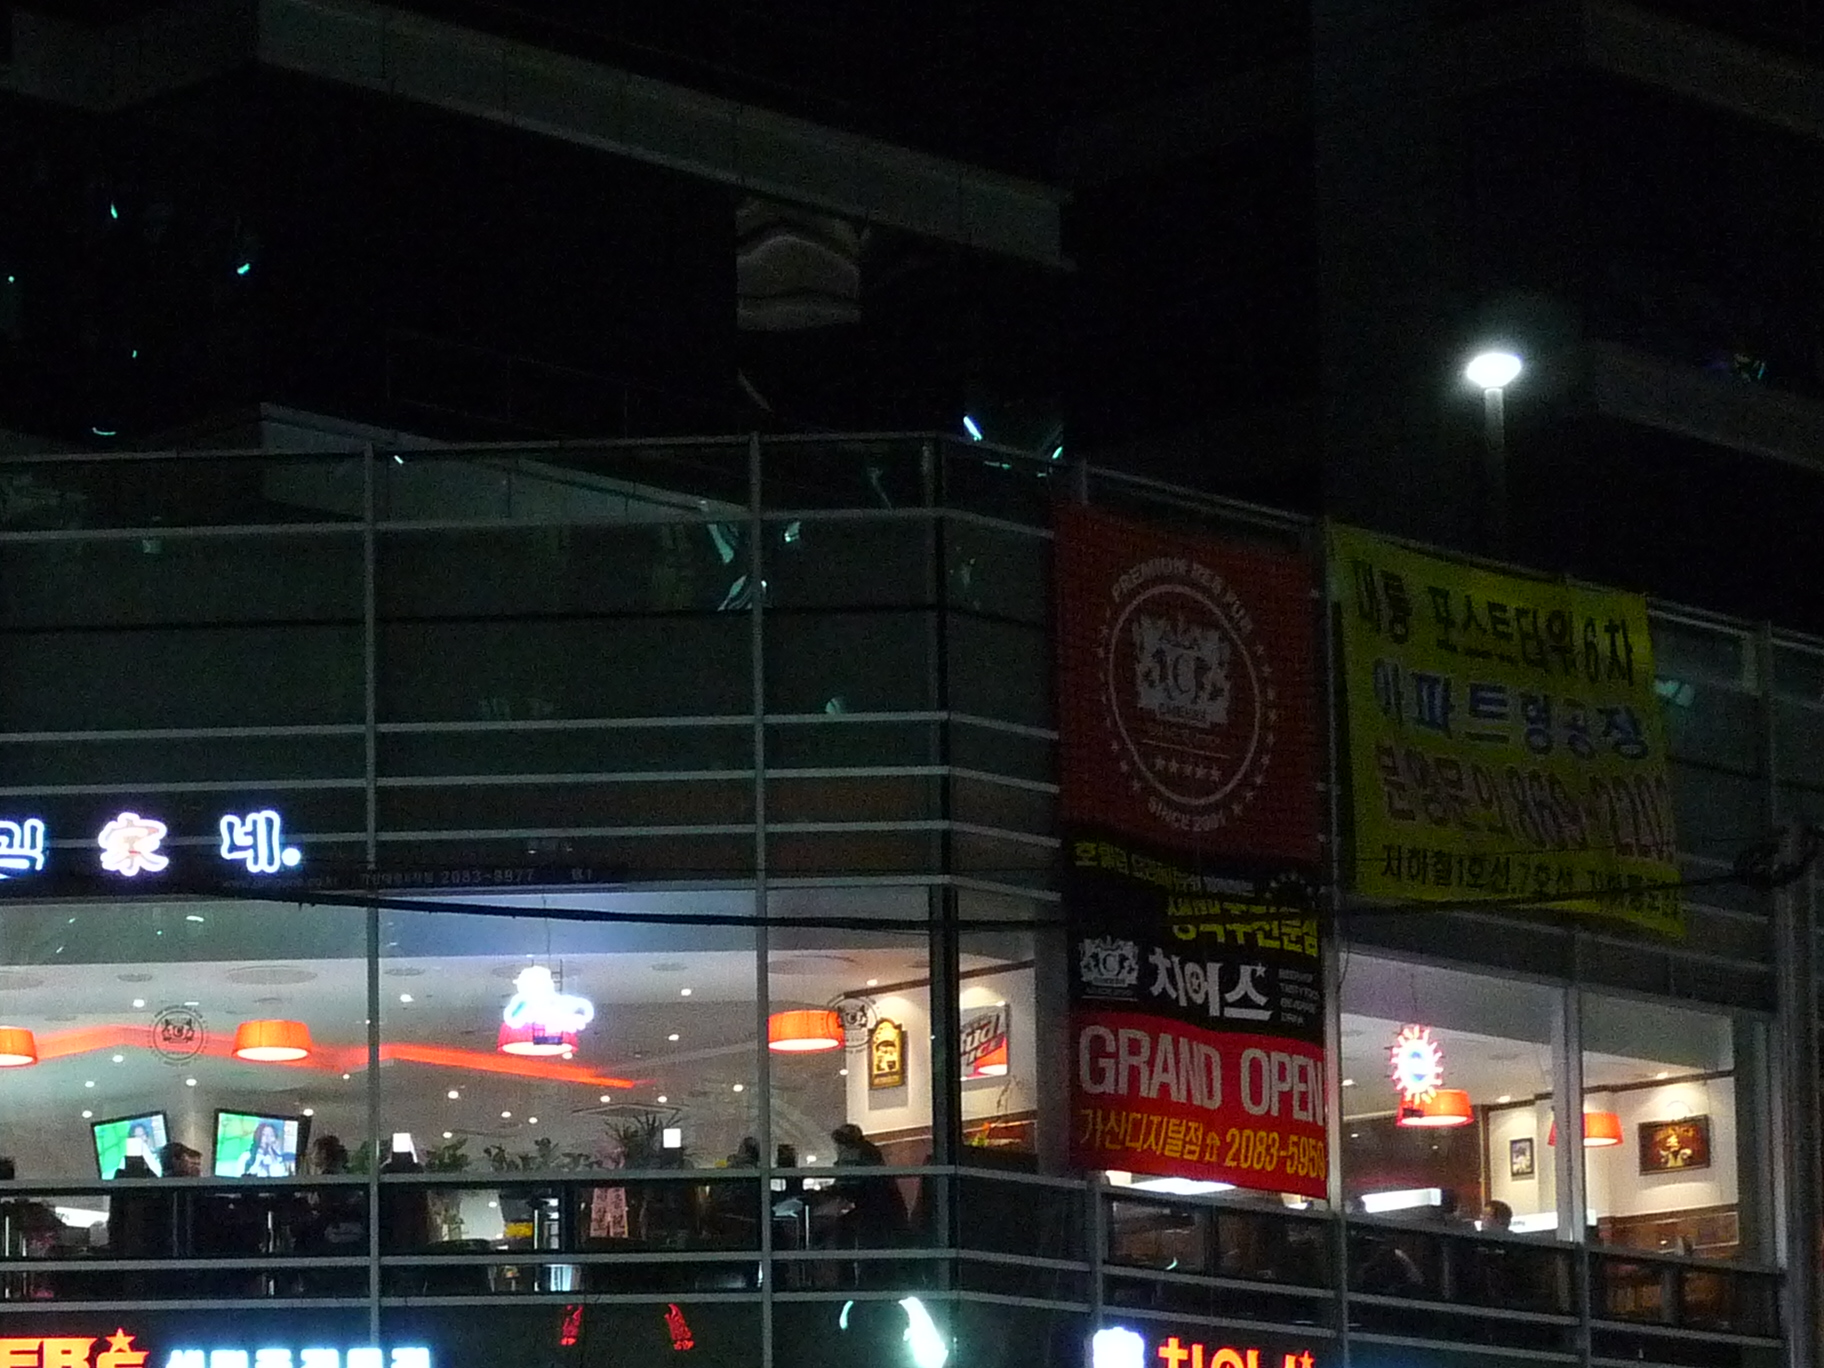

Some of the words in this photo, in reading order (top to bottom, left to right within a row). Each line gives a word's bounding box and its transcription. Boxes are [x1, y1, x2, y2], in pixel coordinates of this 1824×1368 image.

[1148, 945, 1274, 1022] 치어스
[1079, 1024, 1222, 1111] GRAND
[1239, 1047, 1325, 1127] OPEN
[1079, 1108, 1203, 1160] 가산디지털점
